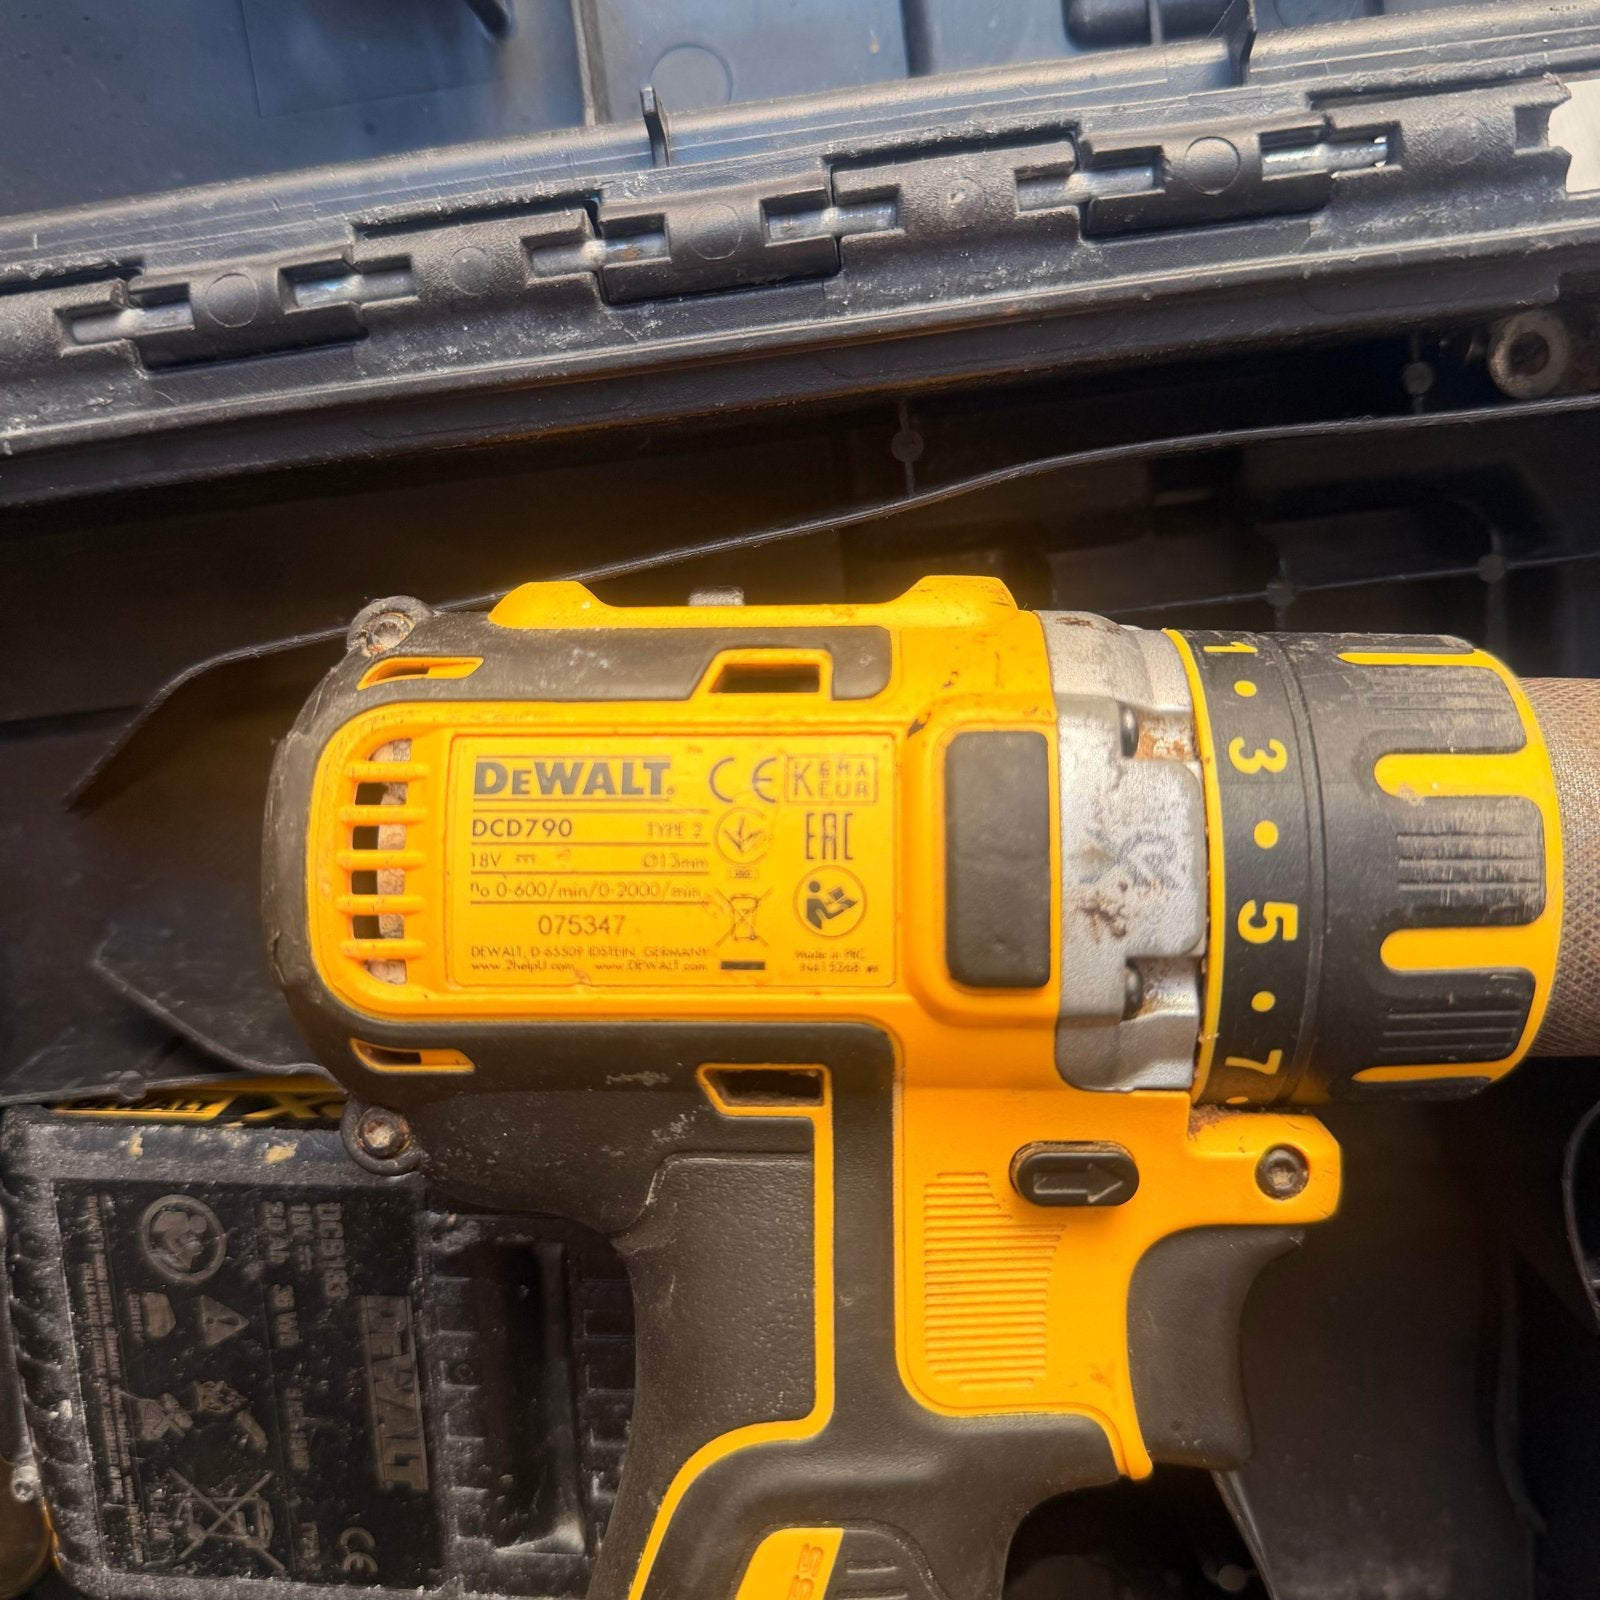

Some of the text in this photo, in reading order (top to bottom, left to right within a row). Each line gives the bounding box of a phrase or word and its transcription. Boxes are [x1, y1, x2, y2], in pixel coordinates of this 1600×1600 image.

[1204, 641, 1257, 653] 1
[1229, 738, 1287, 774] 3
[709, 757, 777, 804] CE
[472, 818, 573, 838] DCD790
[805, 812, 854, 861] EAC
[470, 852, 502, 869] 18V
[538, 914, 626, 936] 075347
[1238, 900, 1298, 943] 5
[1226, 1048, 1282, 1075] 7
[290, 1202, 314, 1241] 18V
[337, 1524, 379, 1576] CE
